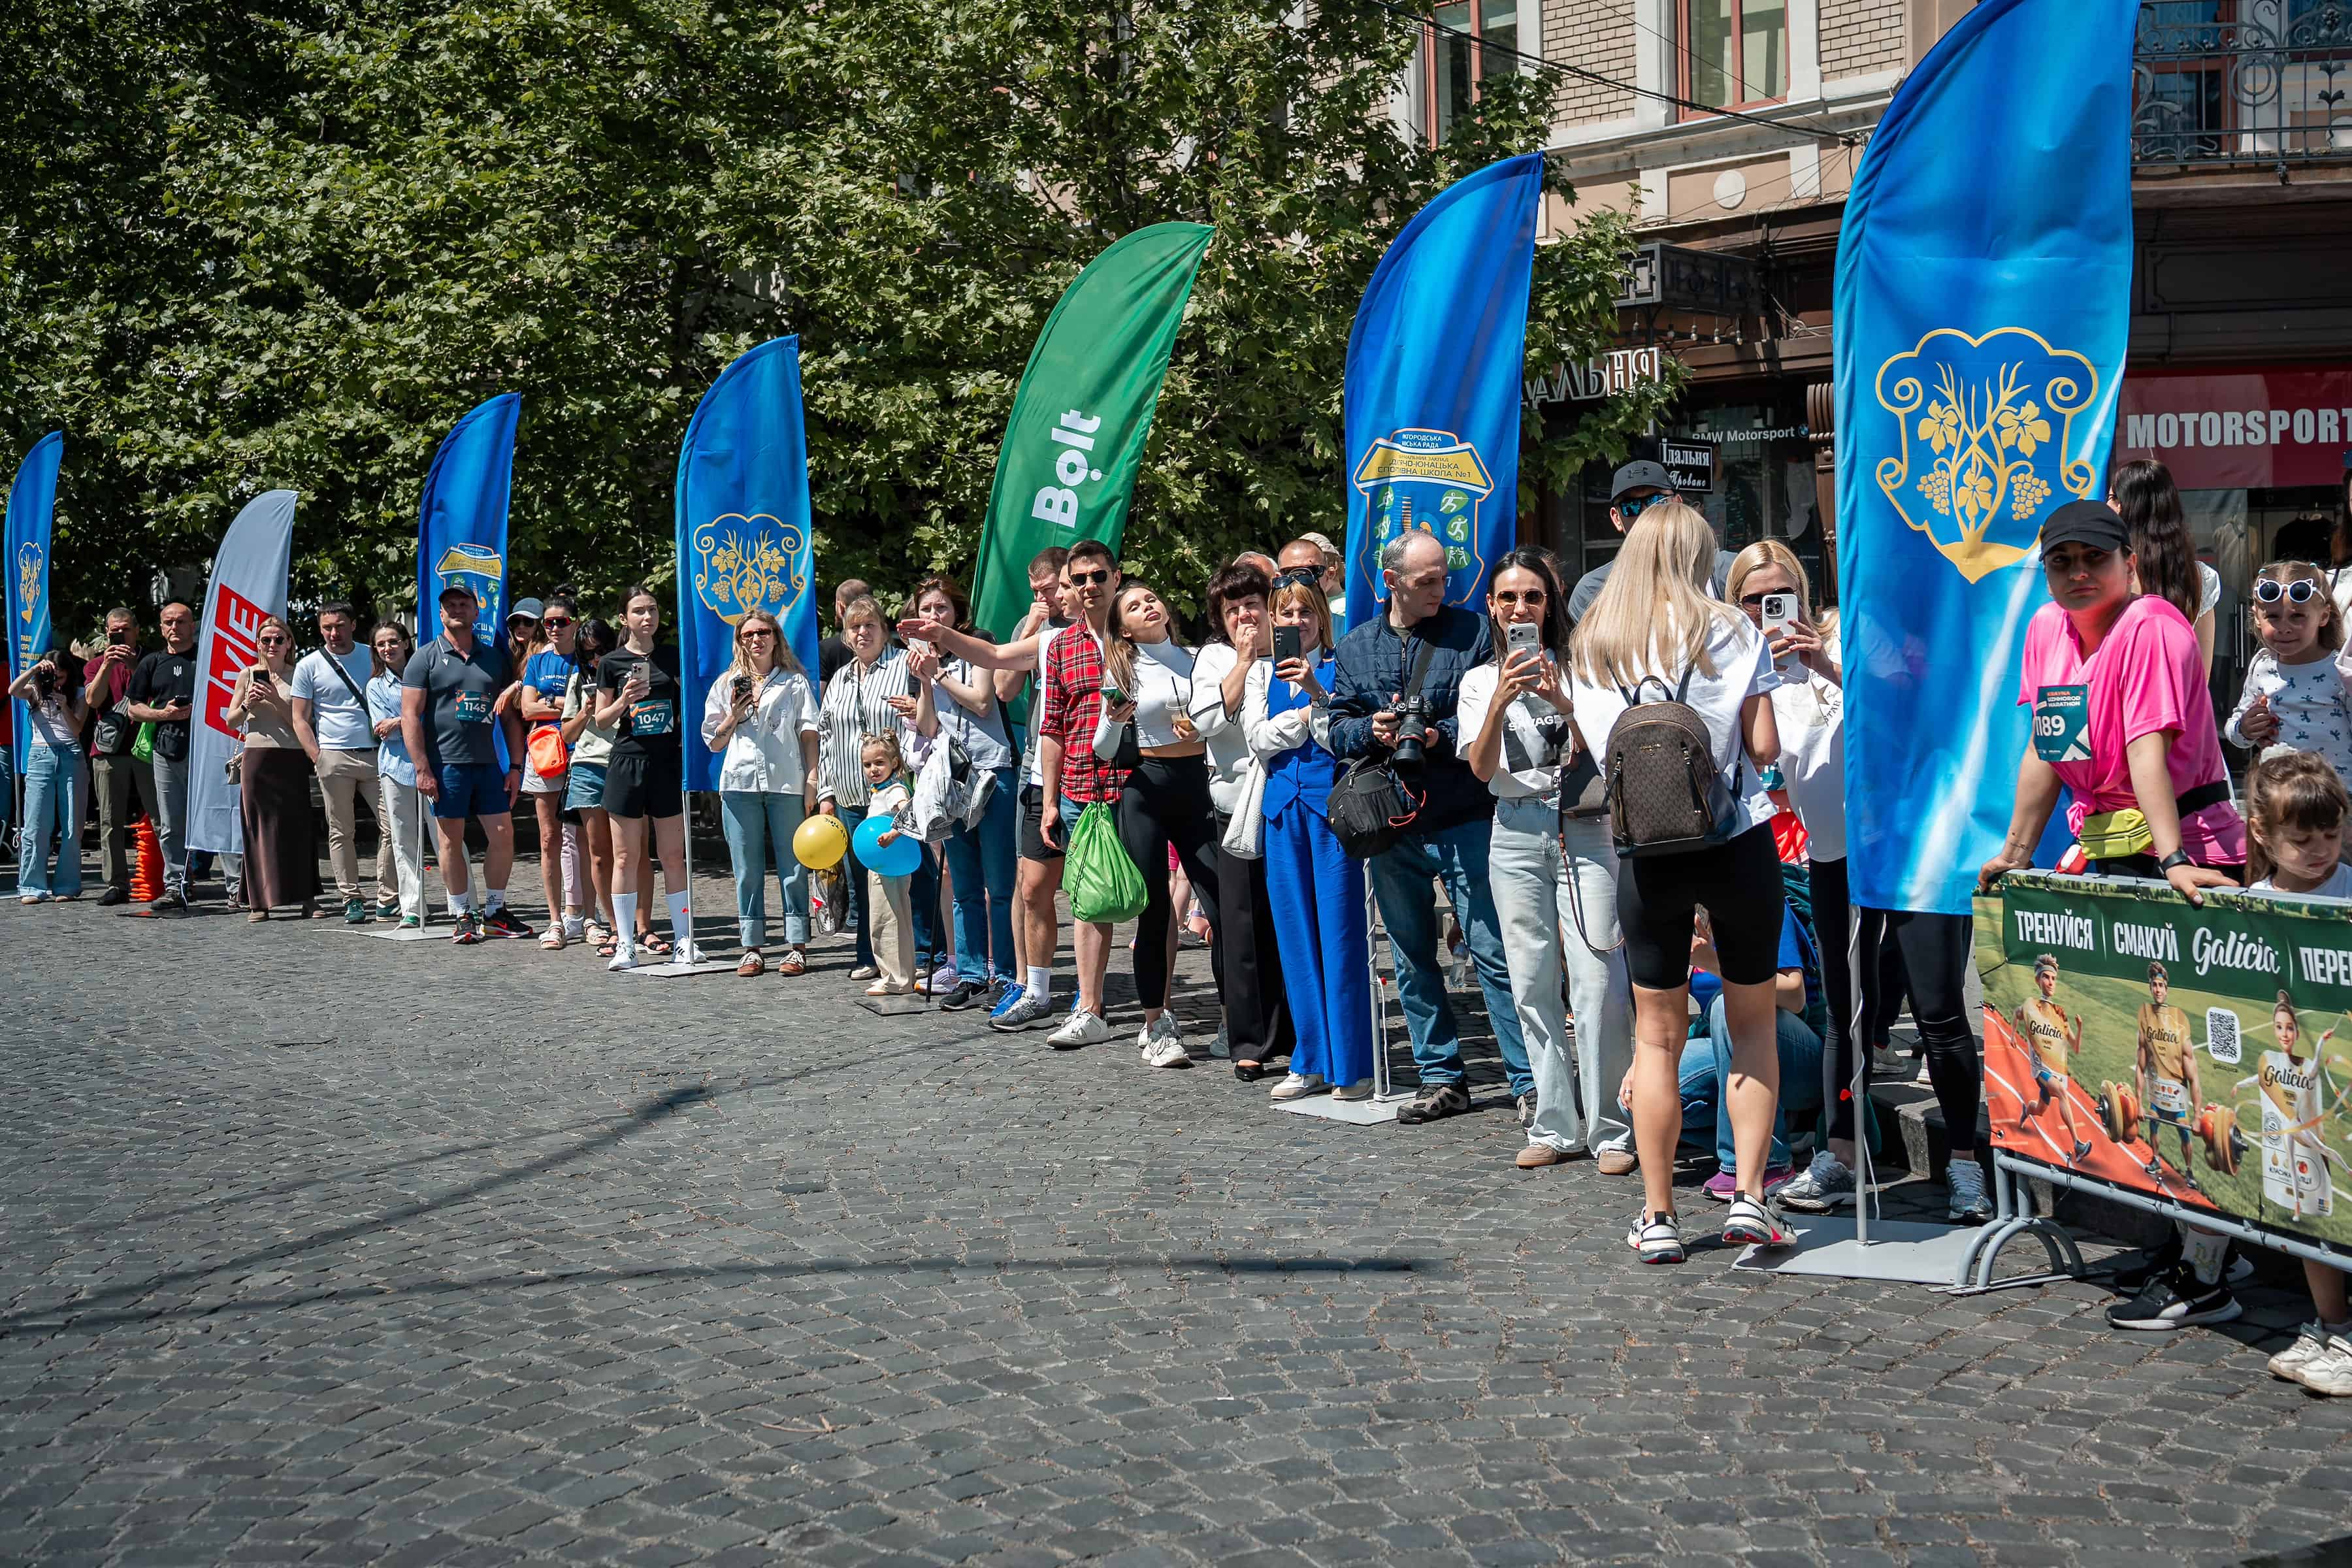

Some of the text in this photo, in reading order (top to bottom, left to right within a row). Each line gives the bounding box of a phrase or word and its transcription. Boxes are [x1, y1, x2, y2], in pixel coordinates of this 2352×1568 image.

[1727, 427, 1795, 442] Motorsport
[1662, 438, 1710, 467] Їдальня
[1031, 409, 1102, 529] Bolt
[1420, 468, 1453, 477] ШКОЛА
[464, 702, 486, 713] 1145
[637, 713, 665, 725] 1047
[2014, 908, 2352, 987] ТРЕНУЙСЯ СМАКУЙ Galicia ПЕРЕ
[2029, 1020, 2064, 1040] Galicia
[2146, 1025, 2180, 1044] Galicia
[2264, 1065, 2314, 1090] Galicia
